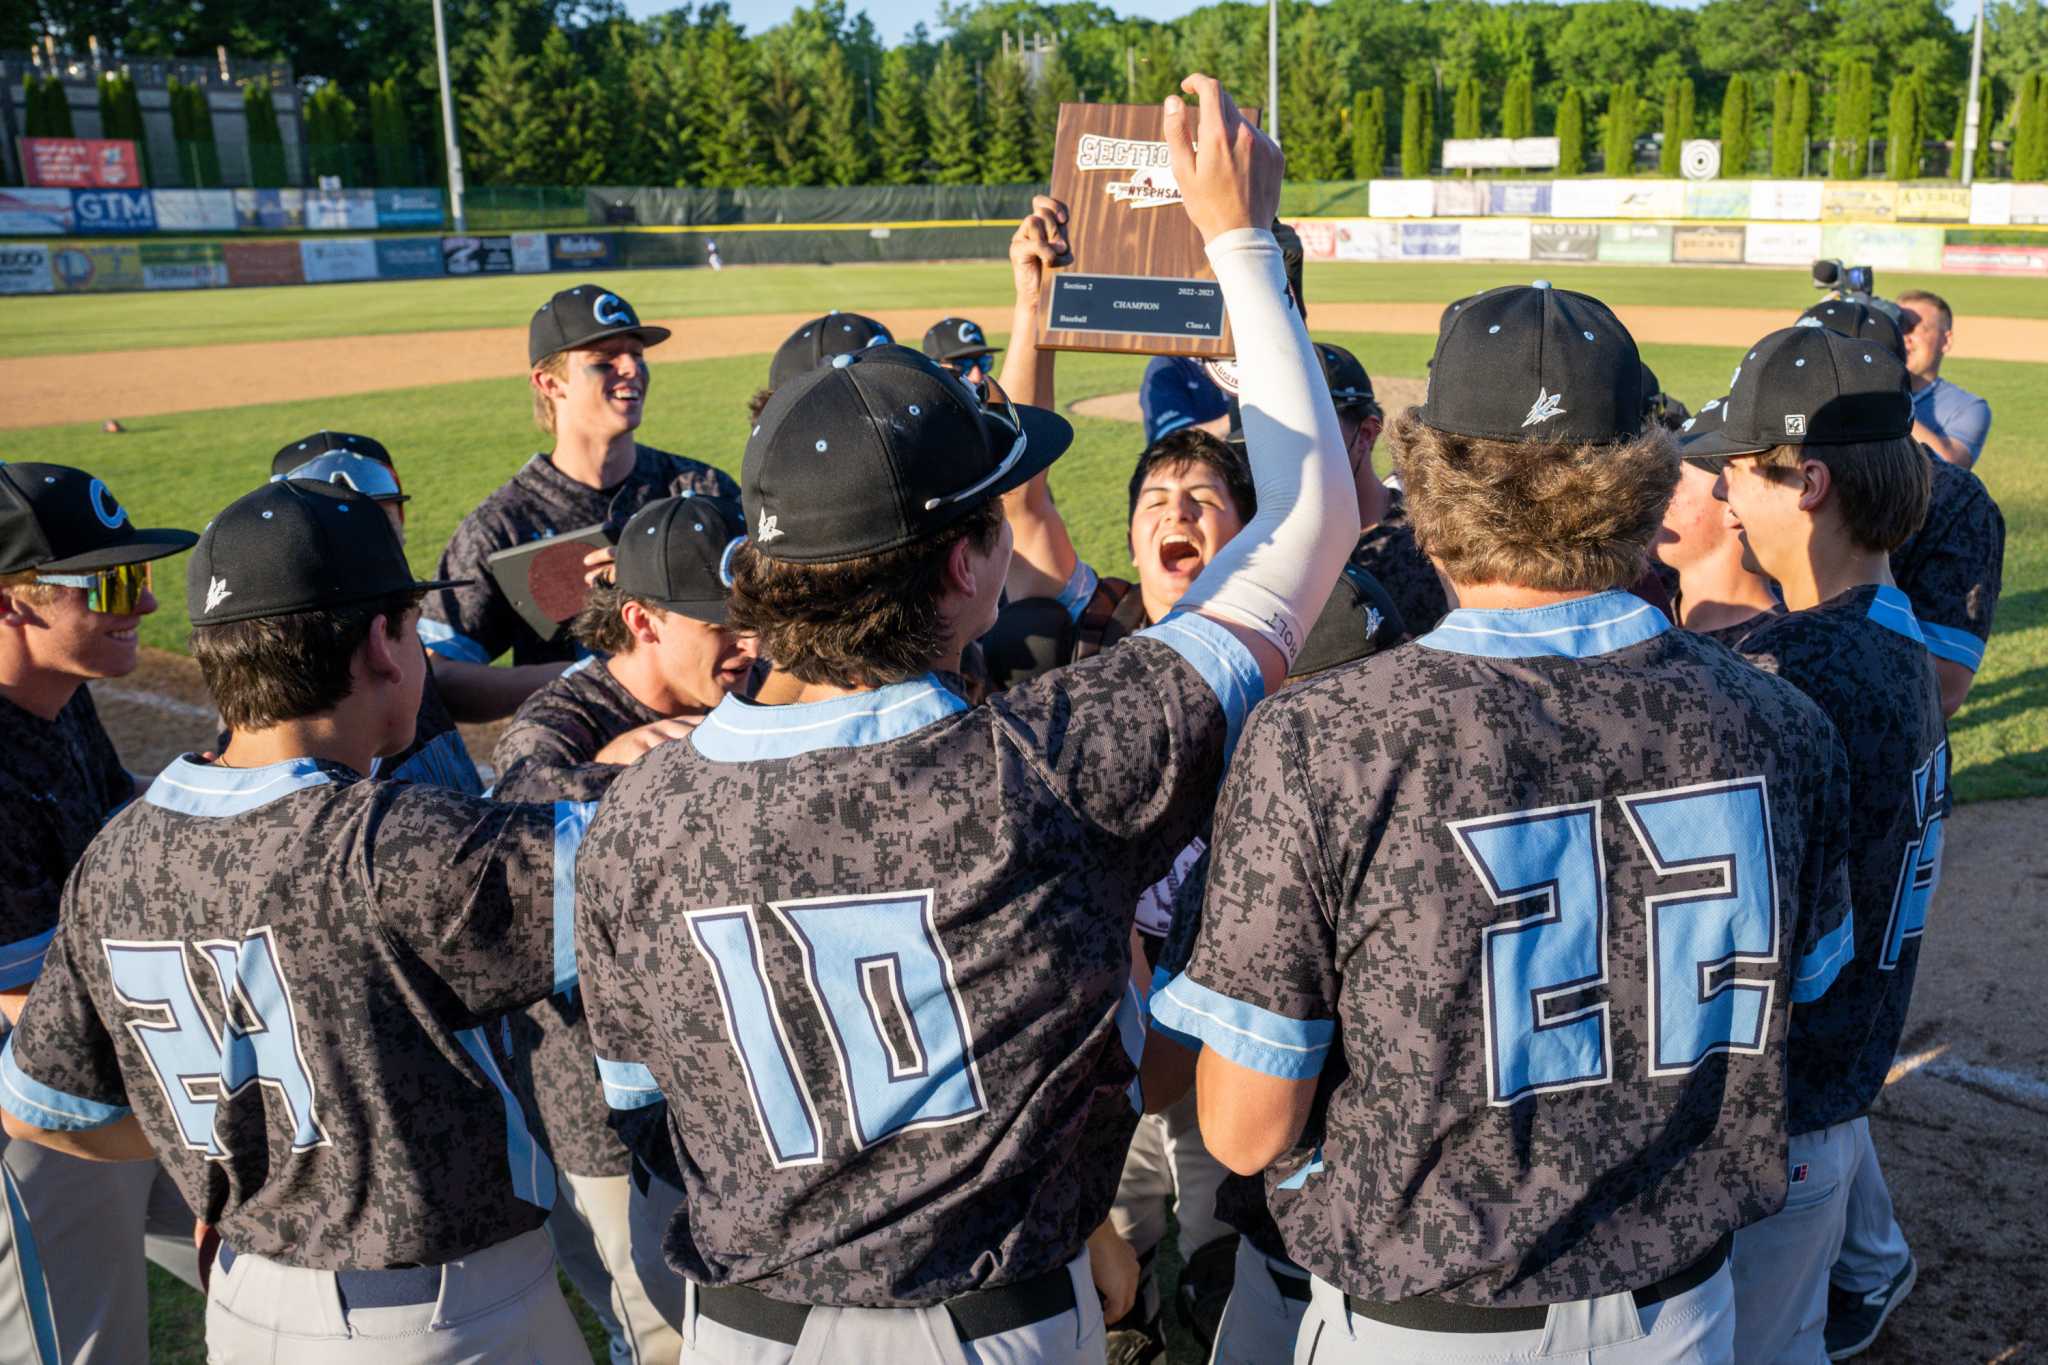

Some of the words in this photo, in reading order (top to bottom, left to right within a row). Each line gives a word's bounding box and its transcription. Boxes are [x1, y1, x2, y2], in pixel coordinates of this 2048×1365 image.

[1080, 136, 1169, 168] SECTIO
[76, 191, 153, 219] GTM
[1128, 185, 1182, 199] NYSPHSA
[1063, 282, 1087, 290] Section
[1087, 283, 1093, 291] 2
[593, 293, 631, 325] C
[1059, 314, 1088, 323] Baseball
[1113, 300, 1160, 311] CHAMPION
[958, 322, 981, 344] C
[1185, 321, 1203, 330] Class
[1204, 322, 1211, 330] A
[89, 478, 128, 530] C
[1445, 775, 1780, 1107] 22
[682, 887, 989, 1169] 10
[101, 924, 333, 1161] 24
